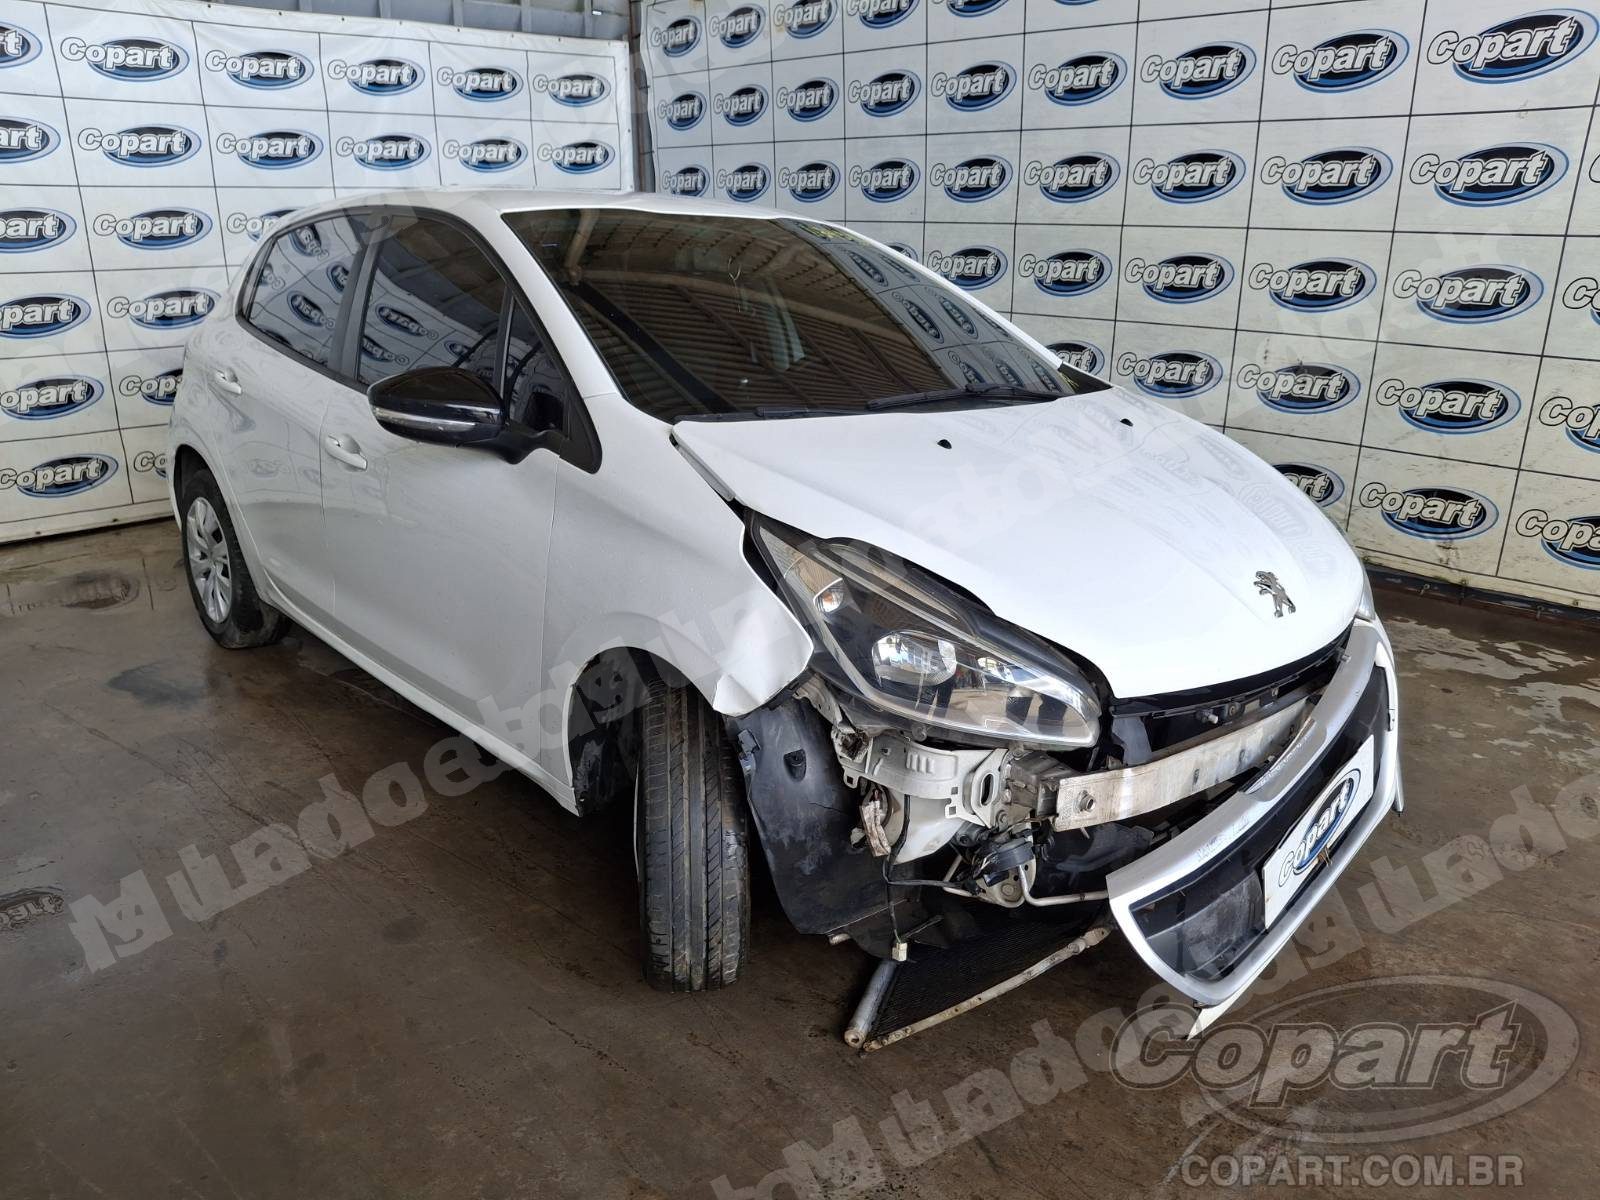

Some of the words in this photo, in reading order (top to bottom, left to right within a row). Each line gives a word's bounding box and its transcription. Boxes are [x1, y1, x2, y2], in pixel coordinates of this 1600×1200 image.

[710, 13, 758, 41] Copart
[774, 2, 829, 30] Copart
[652, 18, 694, 47] Copart
[1427, 16, 1578, 71] Copart
[60, 37, 173, 69] Copart
[205, 50, 300, 80] Copart
[1140, 48, 1243, 89] Copart
[1272, 35, 1391, 81] Copart
[328, 60, 414, 86] Copart
[437, 67, 514, 92] Copart
[533, 74, 602, 98] Copart
[931, 66, 1005, 102] Copart
[1029, 58, 1116, 96] Copart
[714, 90, 762, 118] Copart
[776, 83, 831, 111] Copart
[849, 75, 912, 105] Copart
[658, 93, 700, 122] Copart
[78, 127, 186, 158] Copart
[217, 133, 310, 159] Copart
[336, 137, 421, 161] Copart
[443, 140, 518, 162] Copart
[538, 143, 609, 164] Copart
[663, 169, 705, 195] Copart
[717, 166, 764, 191] Copart
[779, 164, 834, 191] Copart
[849, 162, 912, 193] Copart
[930, 158, 1004, 192] Copart
[1024, 157, 1109, 191] Copart
[1133, 157, 1232, 193] Copart
[1261, 154, 1376, 194] Copart
[1410, 150, 1551, 193] Copart
[93, 213, 197, 242] Copart
[927, 250, 997, 280] Copart
[1018, 253, 1100, 285] Copart
[1125, 257, 1221, 291] Copart
[1249, 263, 1361, 298] Copart
[1393, 269, 1526, 308] Copart
[0, 298, 74, 329] part
[107, 296, 208, 318] Copart
[1117, 352, 1210, 384] Copart
[1236, 364, 1346, 399] Copart
[0, 380, 88, 413] opart
[1376, 379, 1503, 420] Copart
[1359, 482, 1486, 527] Copart
[1278, 777, 1352, 888] Copart
